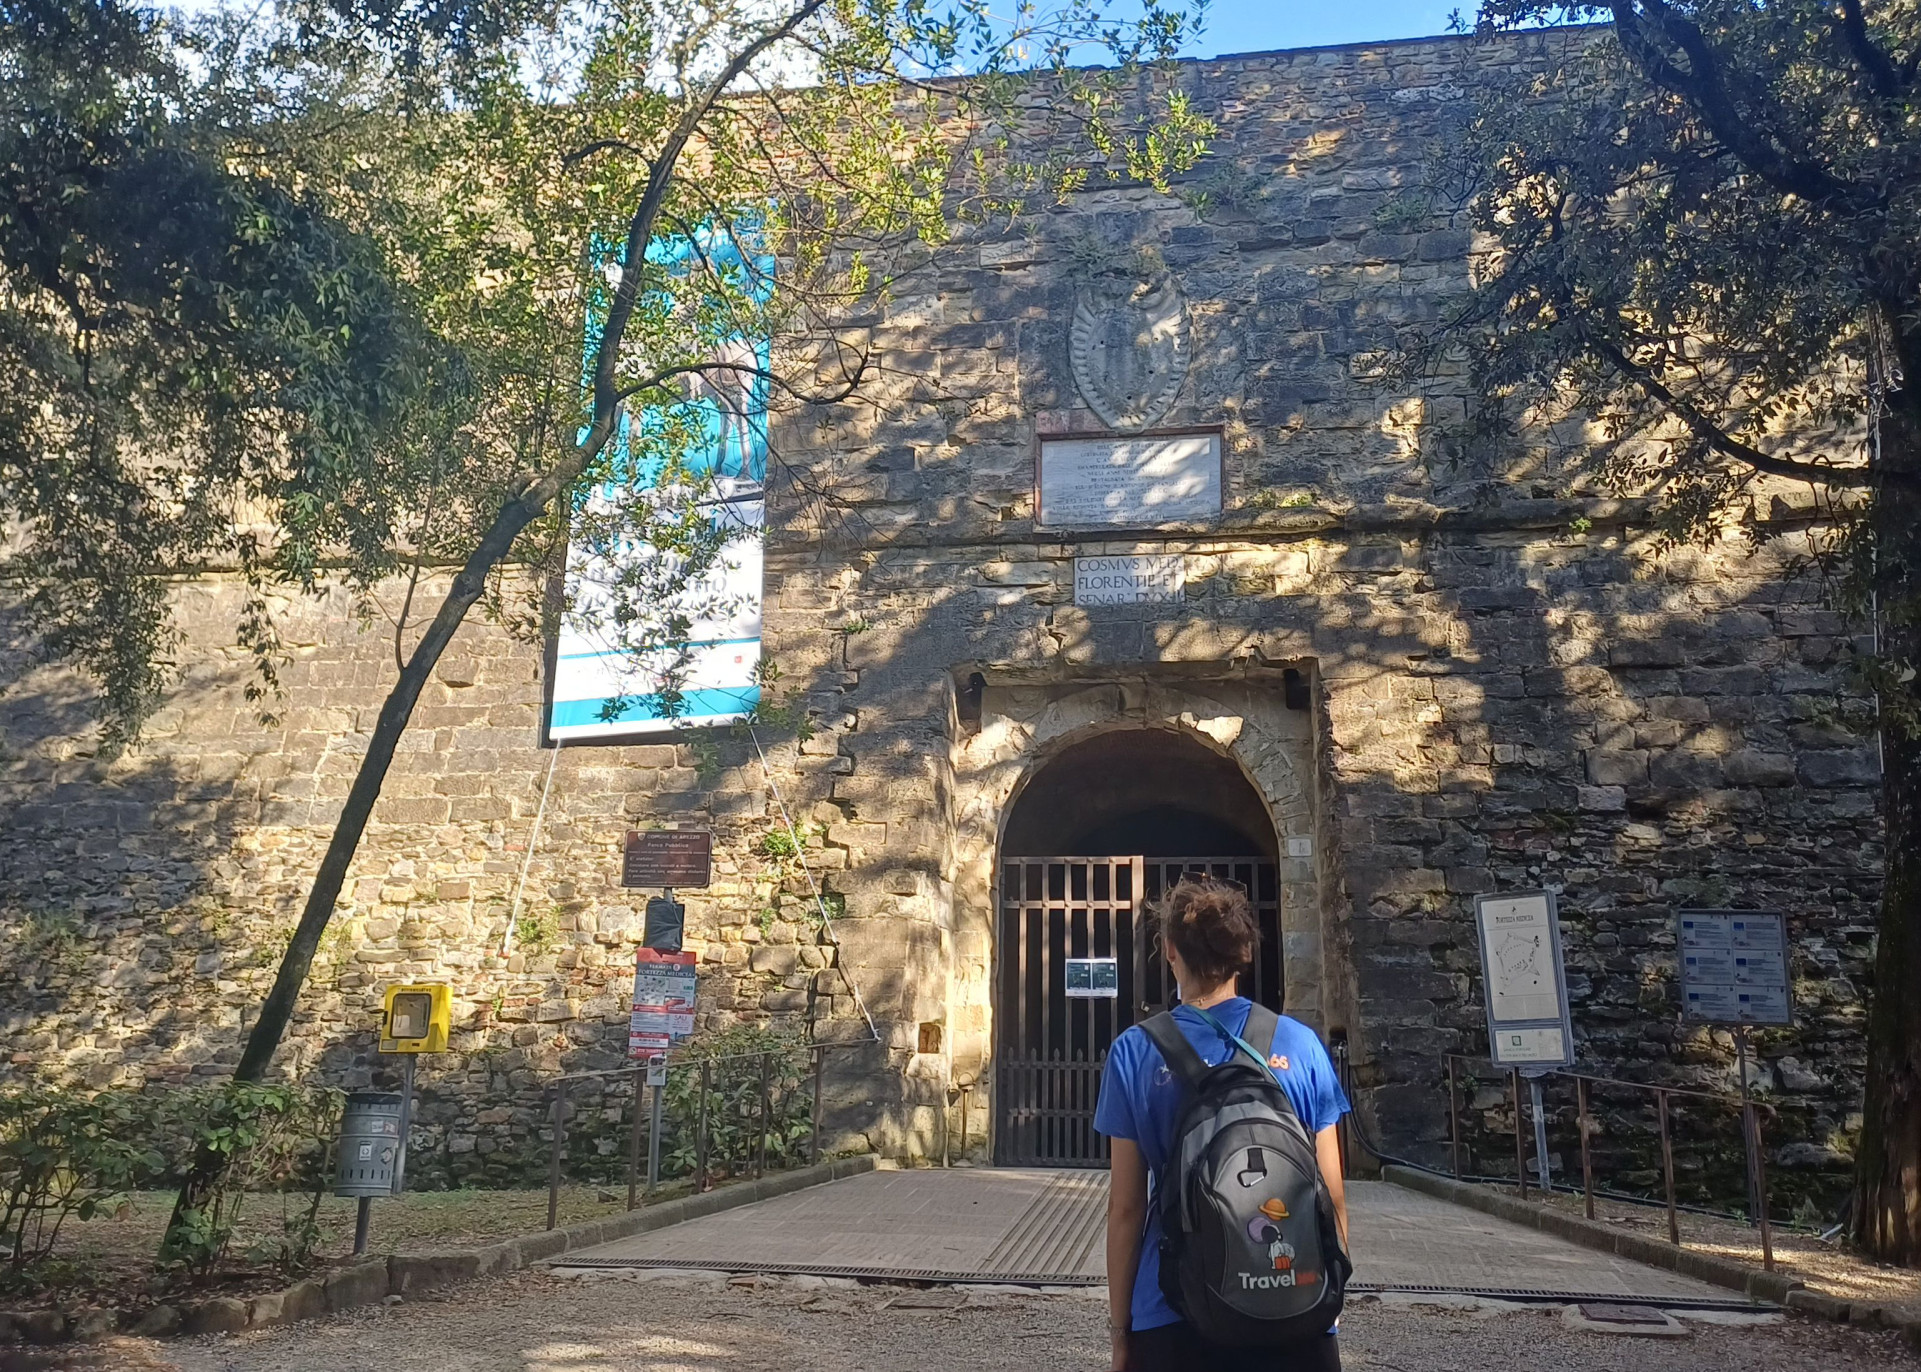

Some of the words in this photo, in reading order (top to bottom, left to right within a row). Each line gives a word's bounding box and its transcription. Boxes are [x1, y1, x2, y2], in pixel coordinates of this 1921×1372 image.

[1077, 557, 1140, 572] COSMVS
[1162, 574, 1177, 588] ET
[638, 968, 666, 976] FORTEZZA
